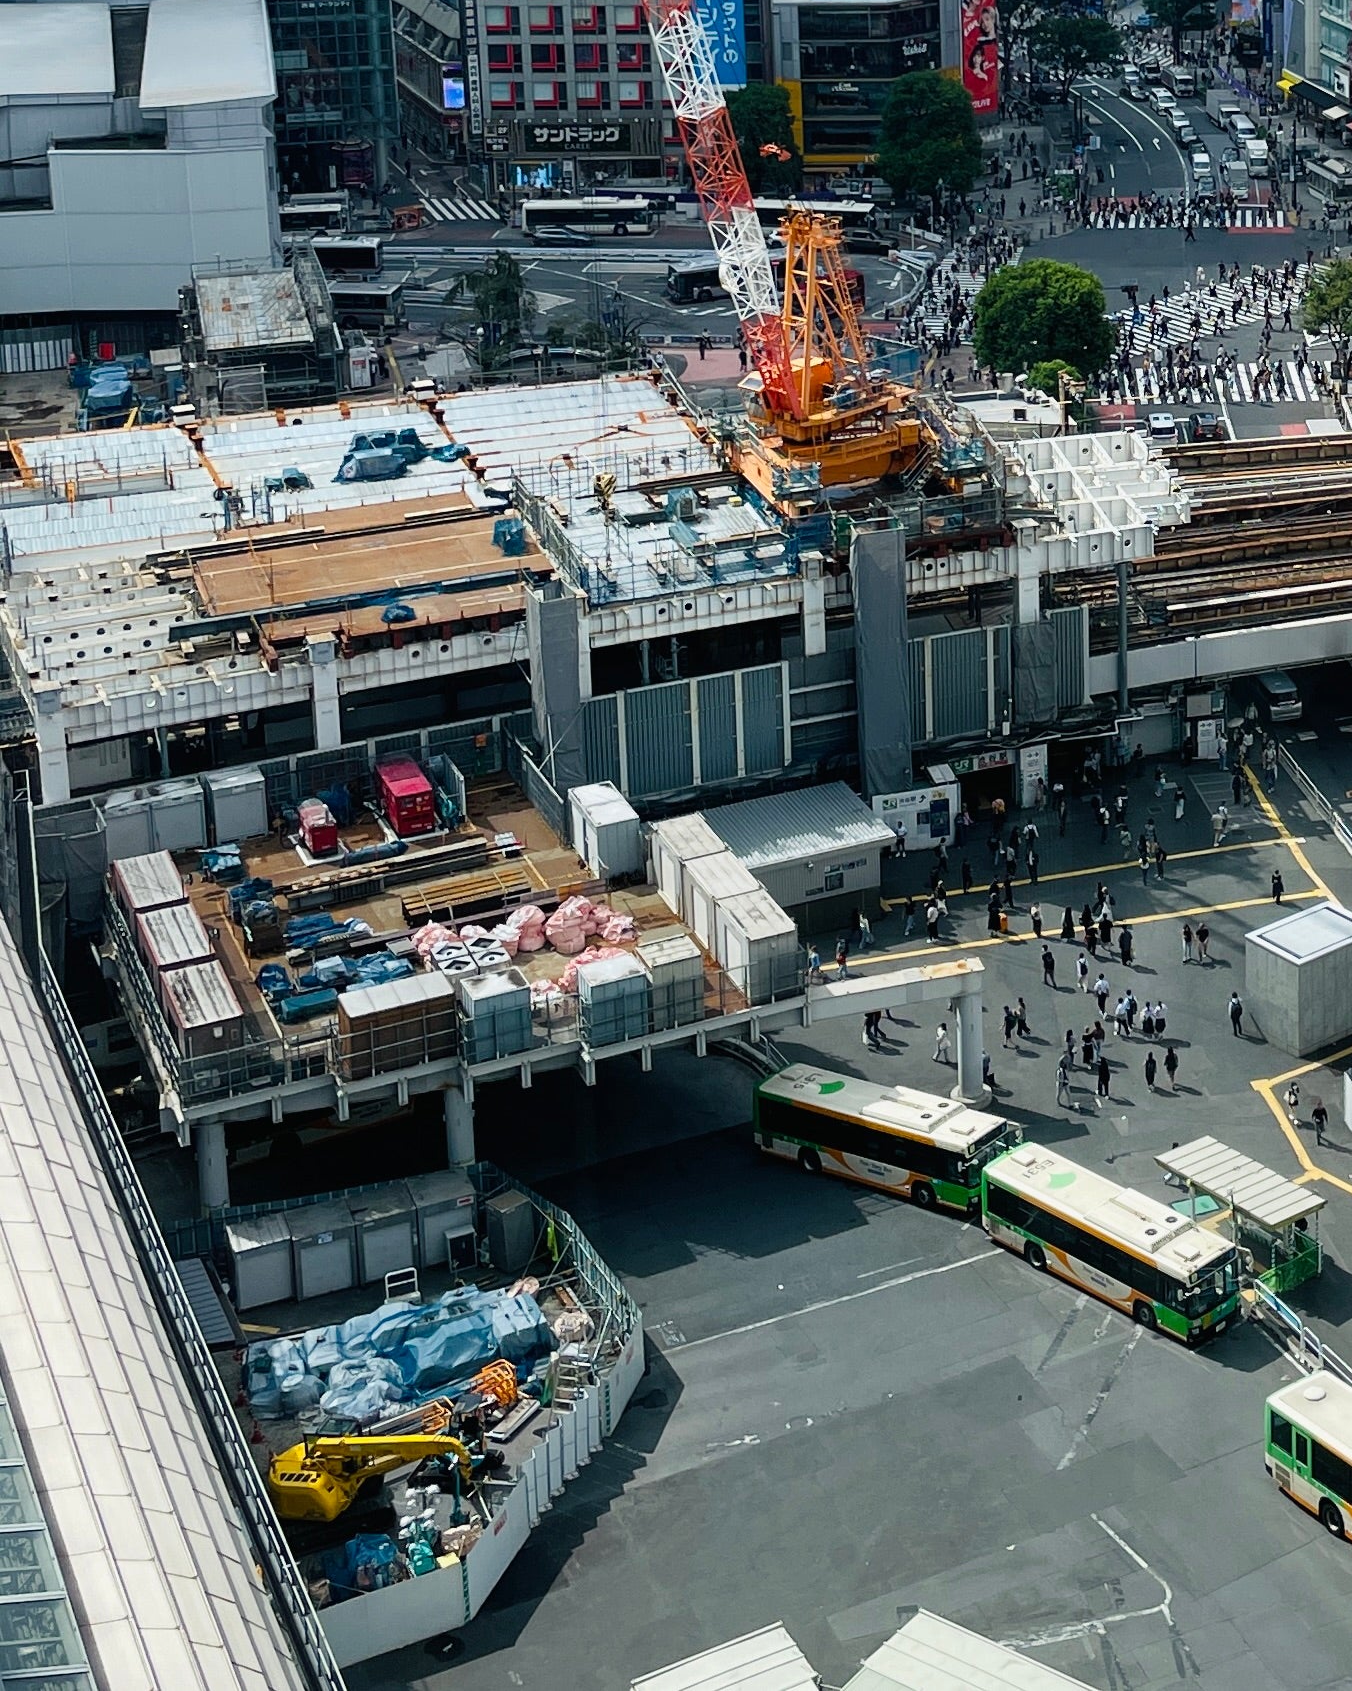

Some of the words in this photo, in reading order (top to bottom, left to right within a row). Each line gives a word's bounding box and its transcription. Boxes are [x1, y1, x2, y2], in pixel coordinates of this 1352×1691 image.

[534, 127, 620, 142] サンドラッグ
[884, 799, 897, 810] JR
[1022, 1160, 1055, 1179] E531
